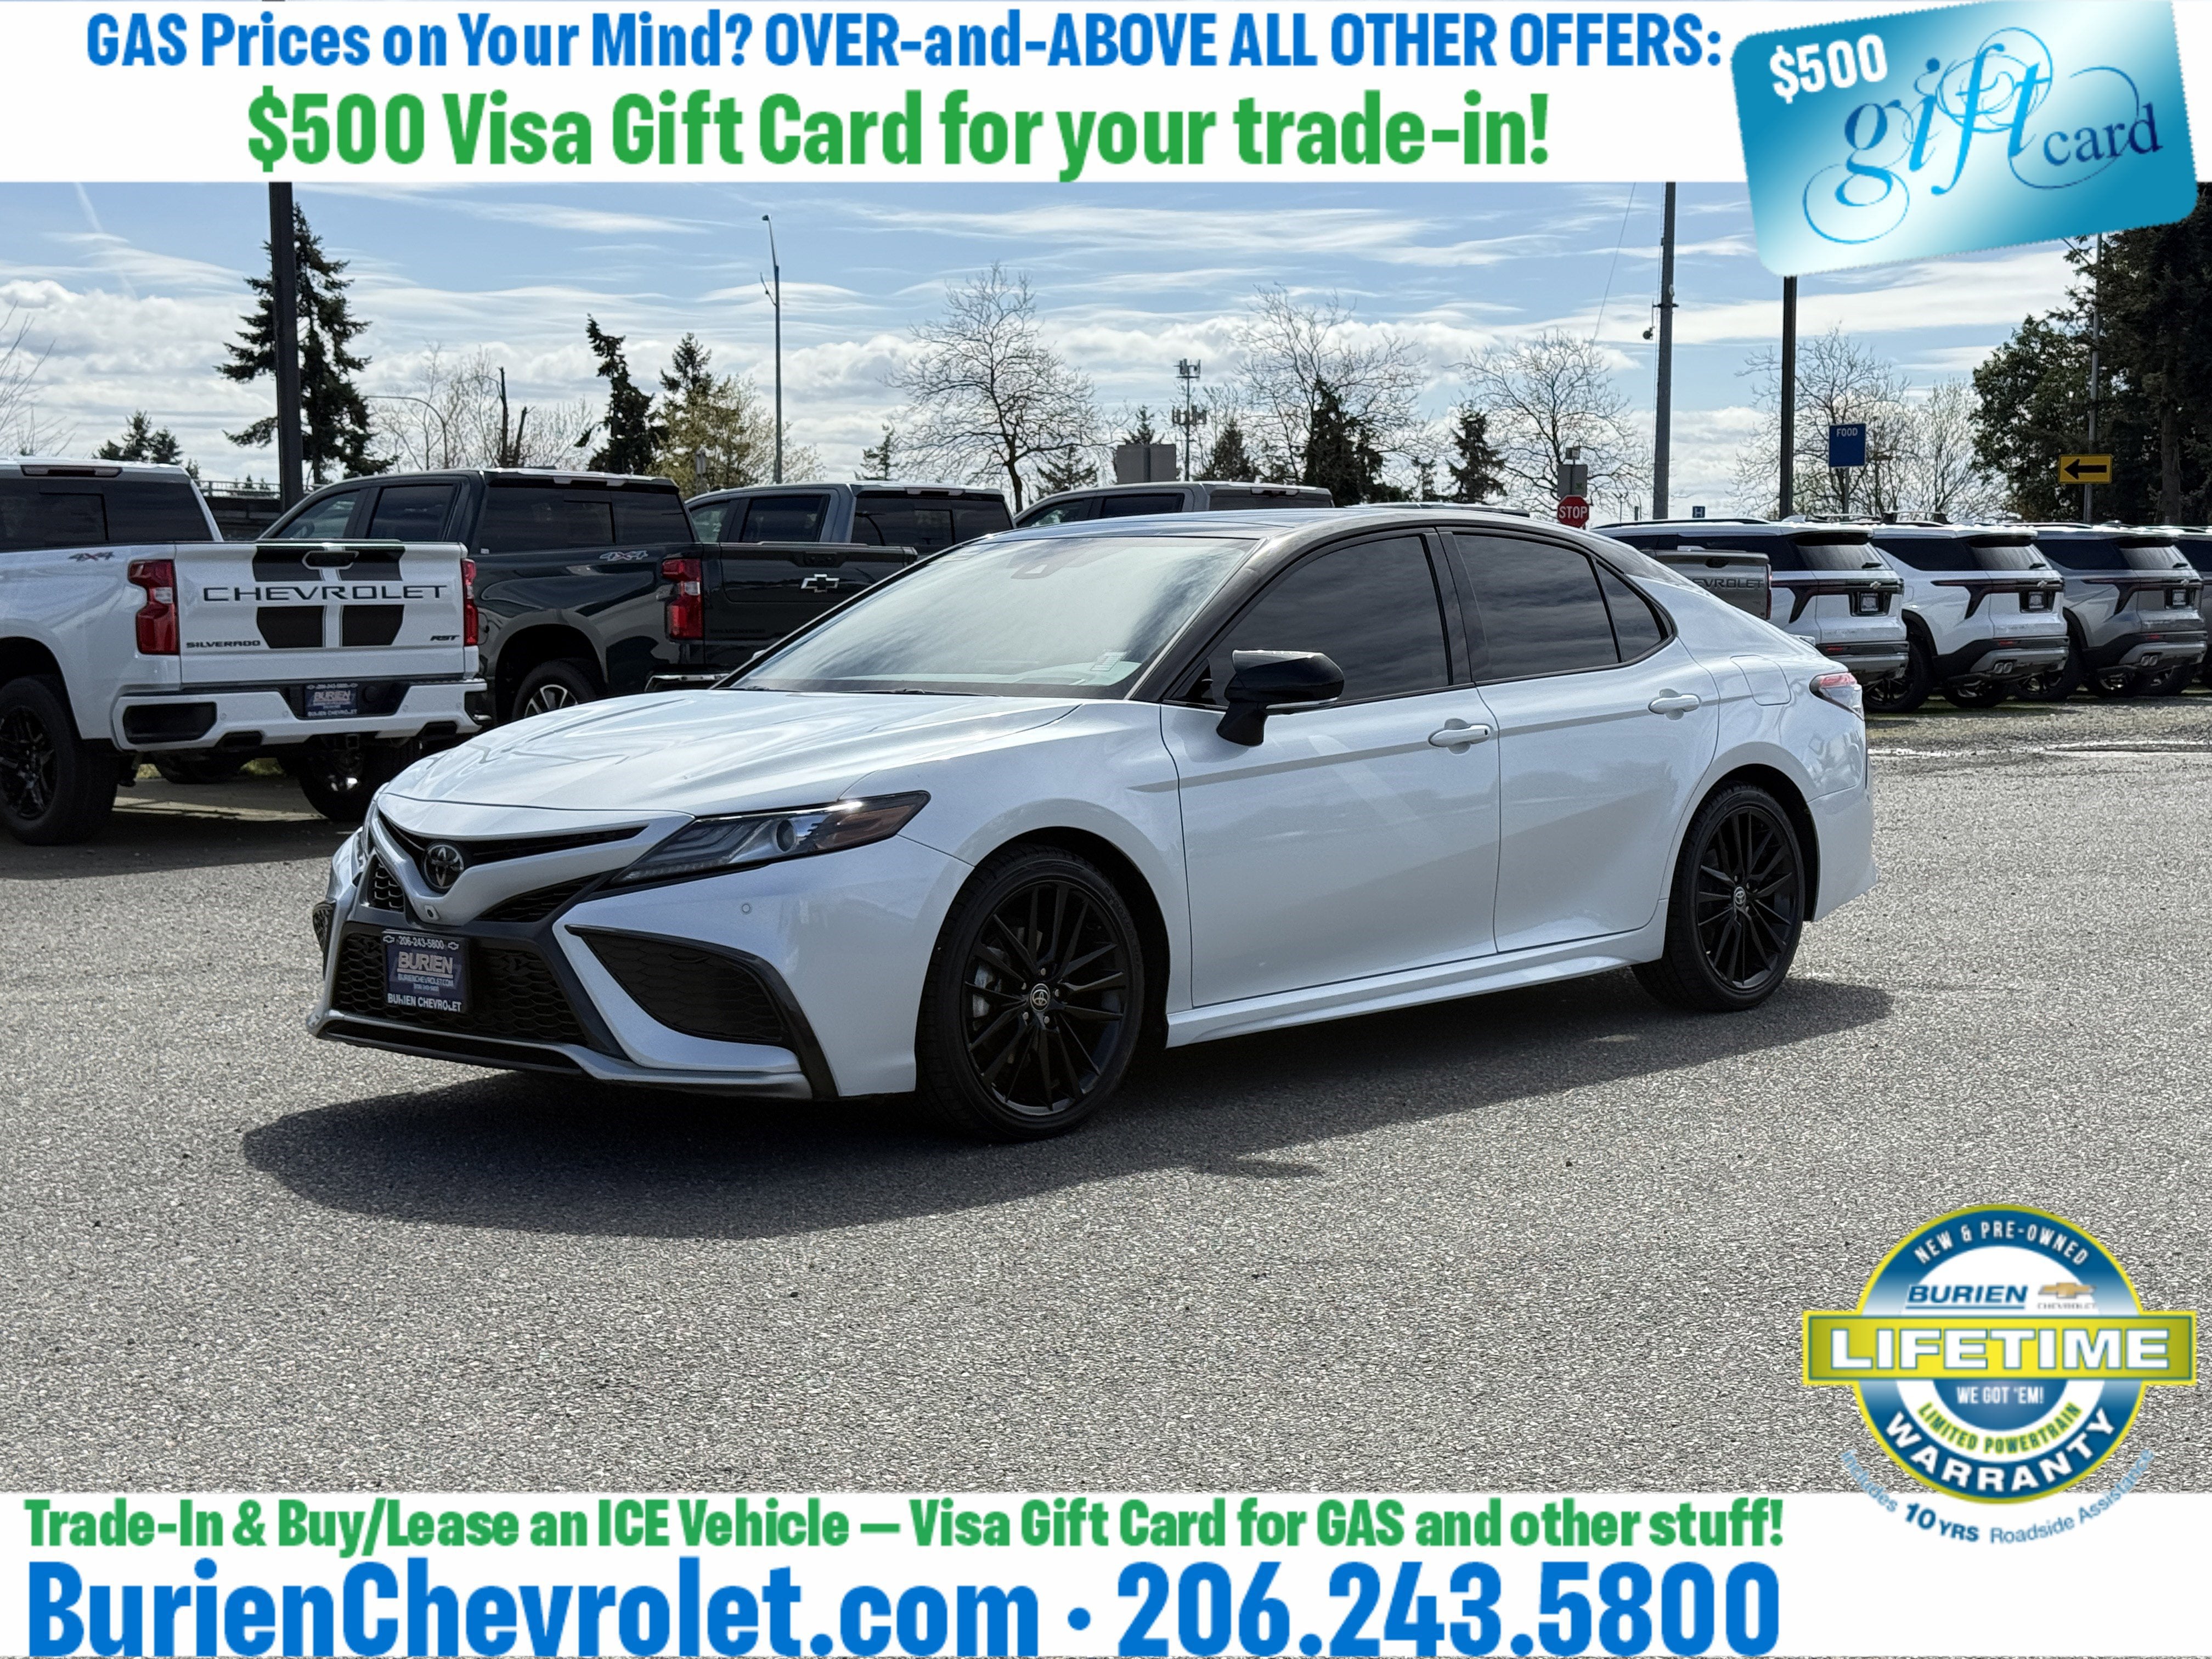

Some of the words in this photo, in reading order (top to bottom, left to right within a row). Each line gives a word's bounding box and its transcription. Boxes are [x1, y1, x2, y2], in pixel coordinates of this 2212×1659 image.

[1837, 427, 1858, 437] FOOD
[1559, 506, 1588, 519] STOP
[1692, 579, 1764, 589] EVROLET
[204, 585, 447, 602] CHEVROLET
[186, 640, 261, 648] SILVERADO
[398, 951, 453, 974] BURIEN
